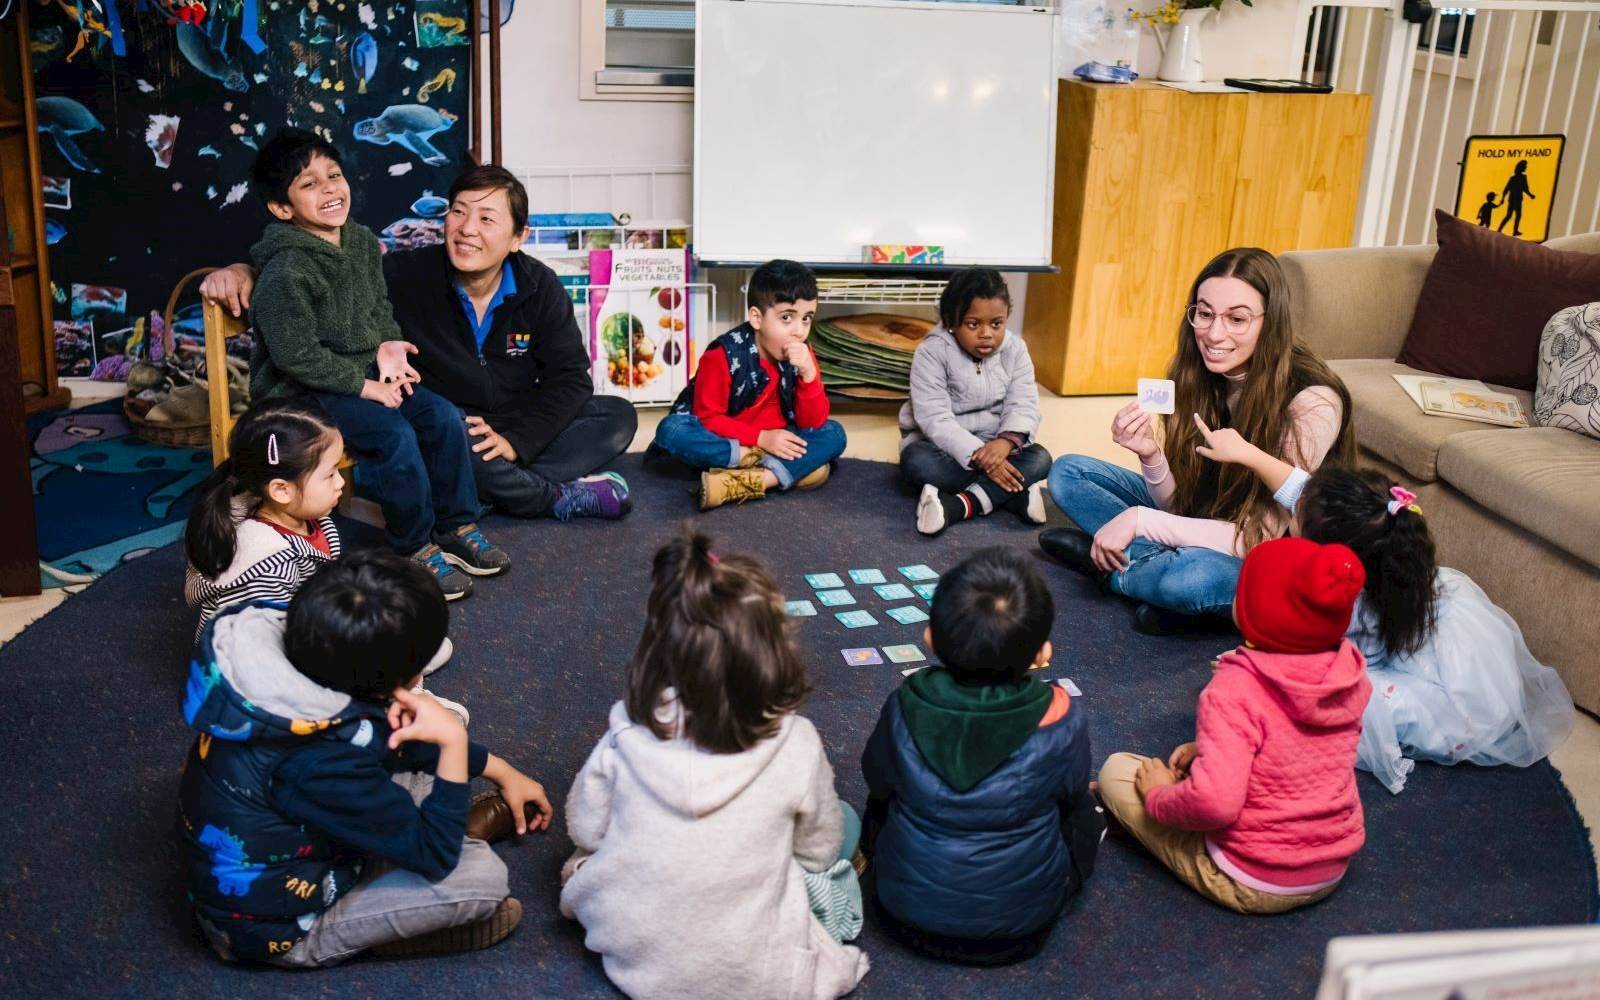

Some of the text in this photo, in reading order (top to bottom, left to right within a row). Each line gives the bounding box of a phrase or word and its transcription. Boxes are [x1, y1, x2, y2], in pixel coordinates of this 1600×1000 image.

[1477, 148, 1552, 158] HOLD MY HAND
[656, 264, 683, 273] NUTS
[620, 273, 681, 281] VEGETABLES
